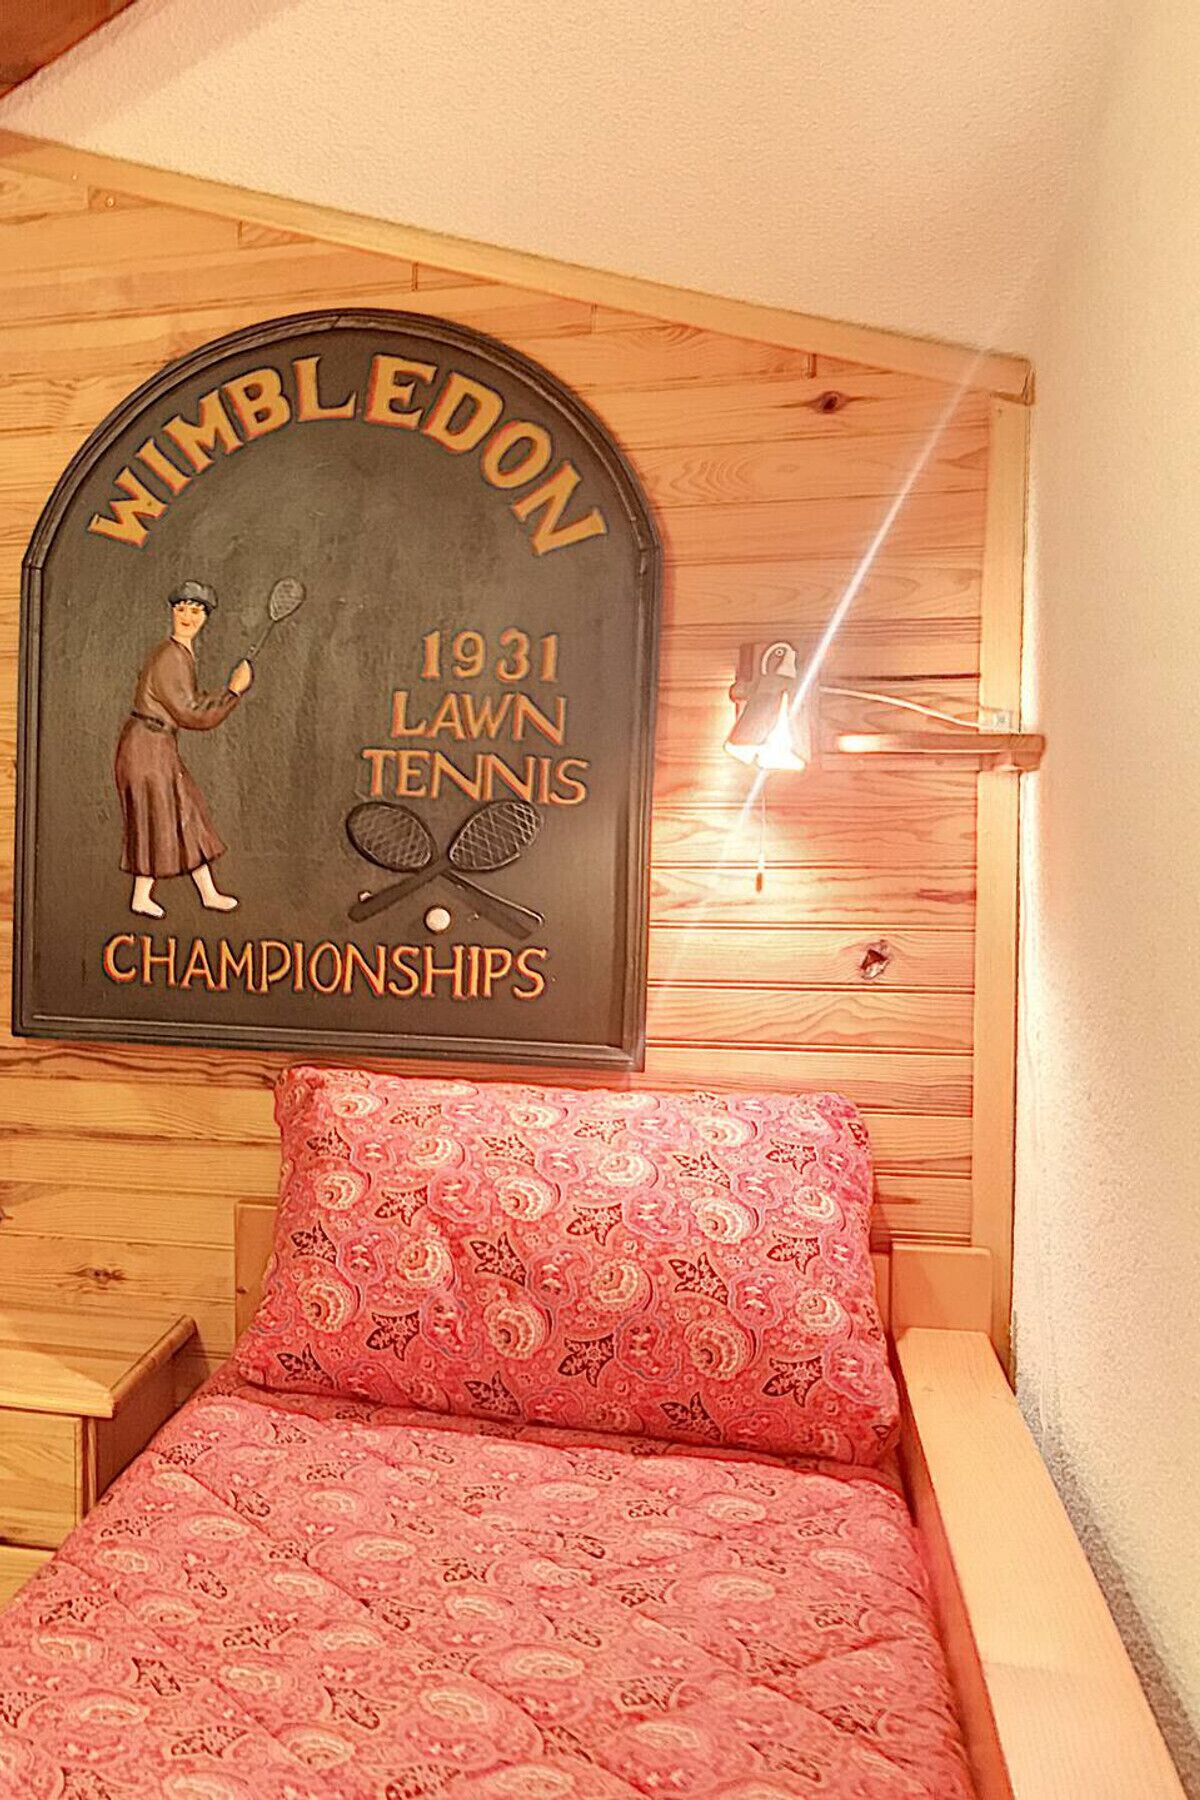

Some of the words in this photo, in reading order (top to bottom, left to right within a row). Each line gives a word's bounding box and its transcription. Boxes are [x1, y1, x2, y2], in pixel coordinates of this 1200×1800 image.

[88, 352, 608, 557] WIMBLEDON
[421, 628, 560, 684] 1931
[390, 690, 568, 746] LAWN
[361, 748, 589, 806] TENNIS
[103, 933, 549, 1000] CHAMPIONSHIPS
